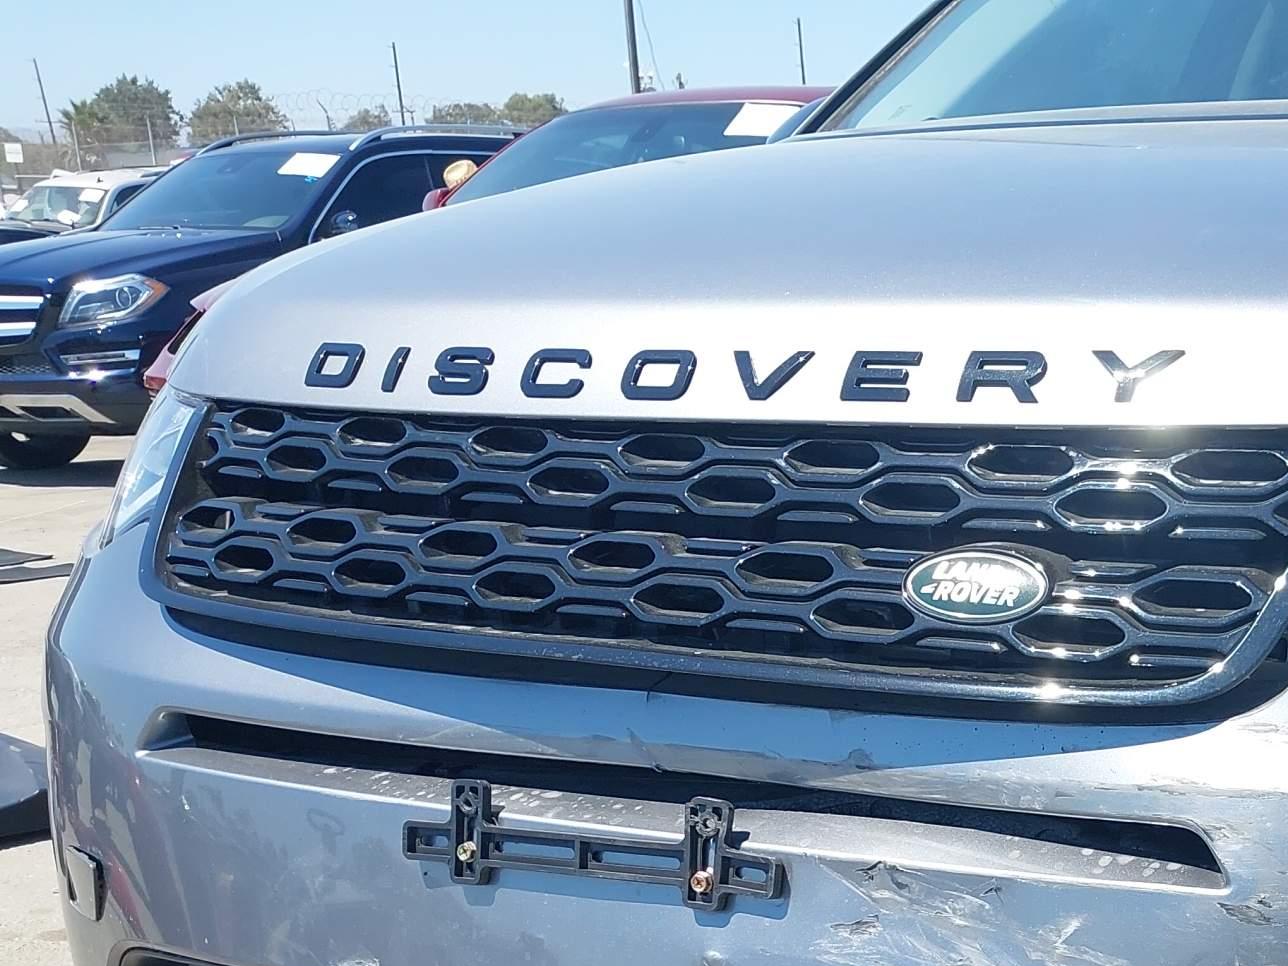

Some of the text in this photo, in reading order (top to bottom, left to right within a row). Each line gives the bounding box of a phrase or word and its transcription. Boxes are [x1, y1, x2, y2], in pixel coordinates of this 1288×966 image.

[304, 342, 1187, 403] DISCOVERY
[932, 561, 1008, 583] LAN
[932, 581, 1020, 607] ROVER
